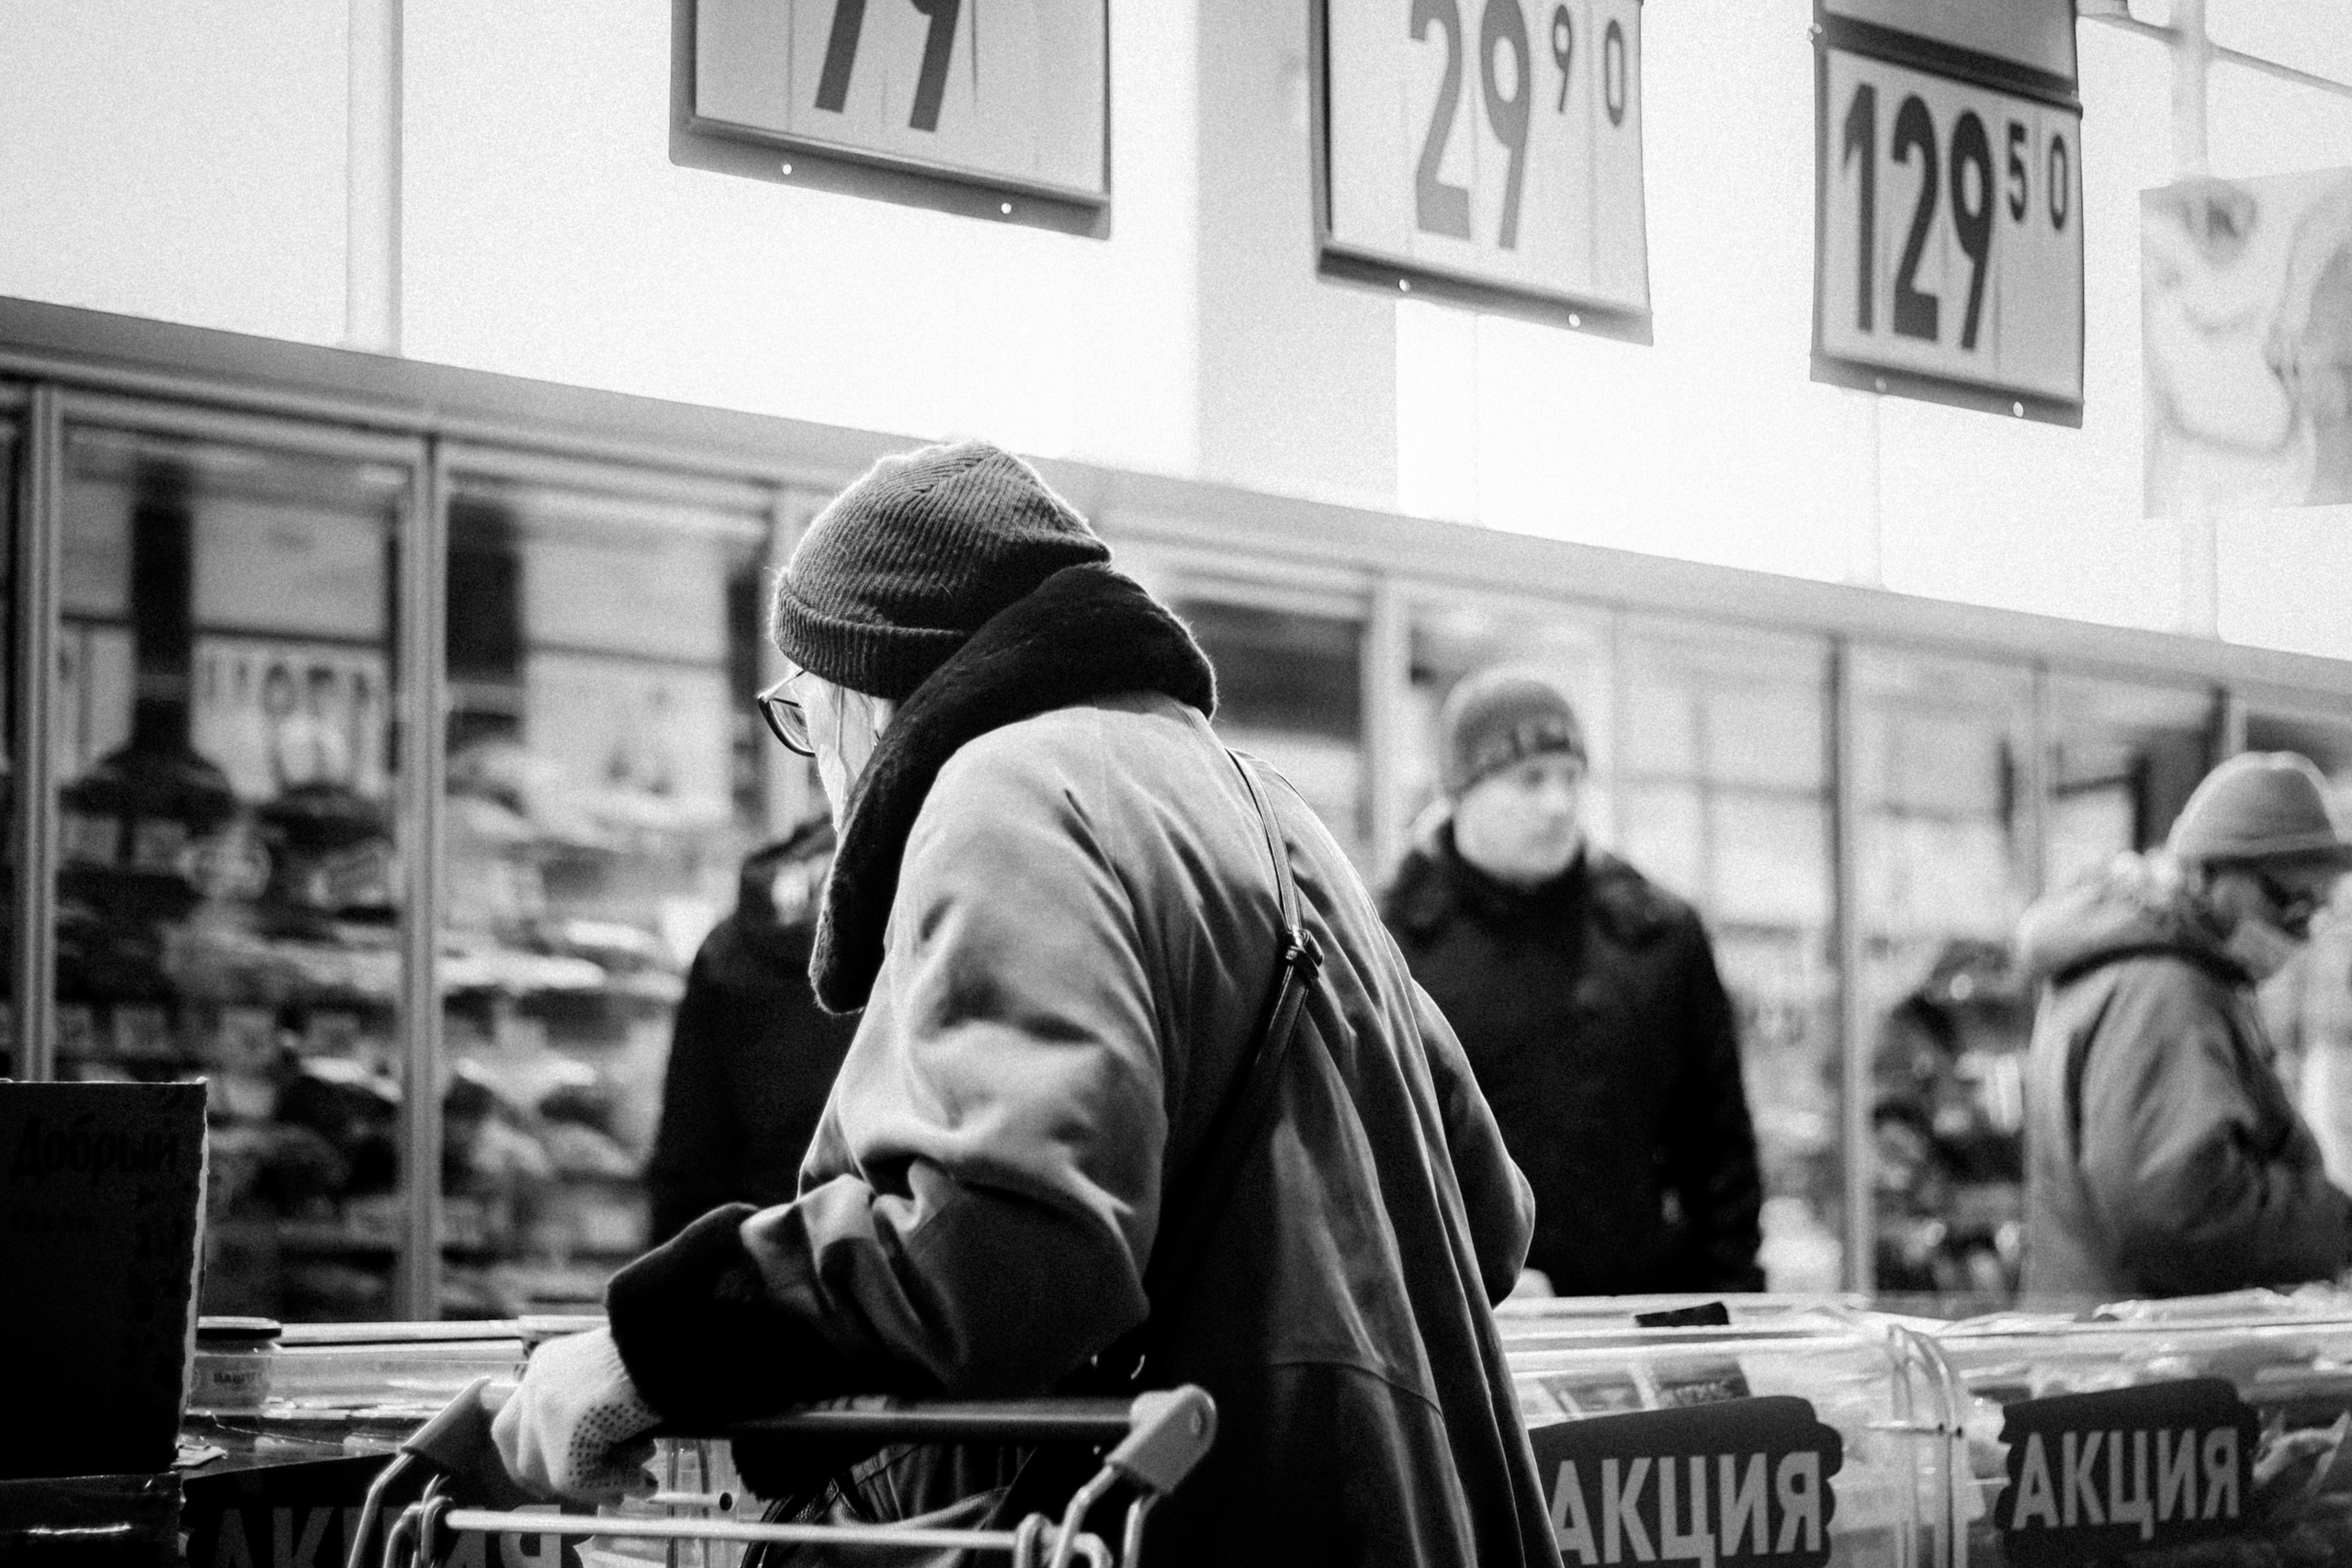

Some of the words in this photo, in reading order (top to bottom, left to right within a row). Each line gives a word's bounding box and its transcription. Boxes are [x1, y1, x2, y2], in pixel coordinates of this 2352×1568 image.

[1410, 0, 1532, 250] 29
[1844, 83, 1996, 352] 129
[2007, 120, 2068, 232] 50
[1551, 1451, 1822, 1568] АКЦИЯ
[2011, 1427, 2241, 1541] АКЦИЯ
